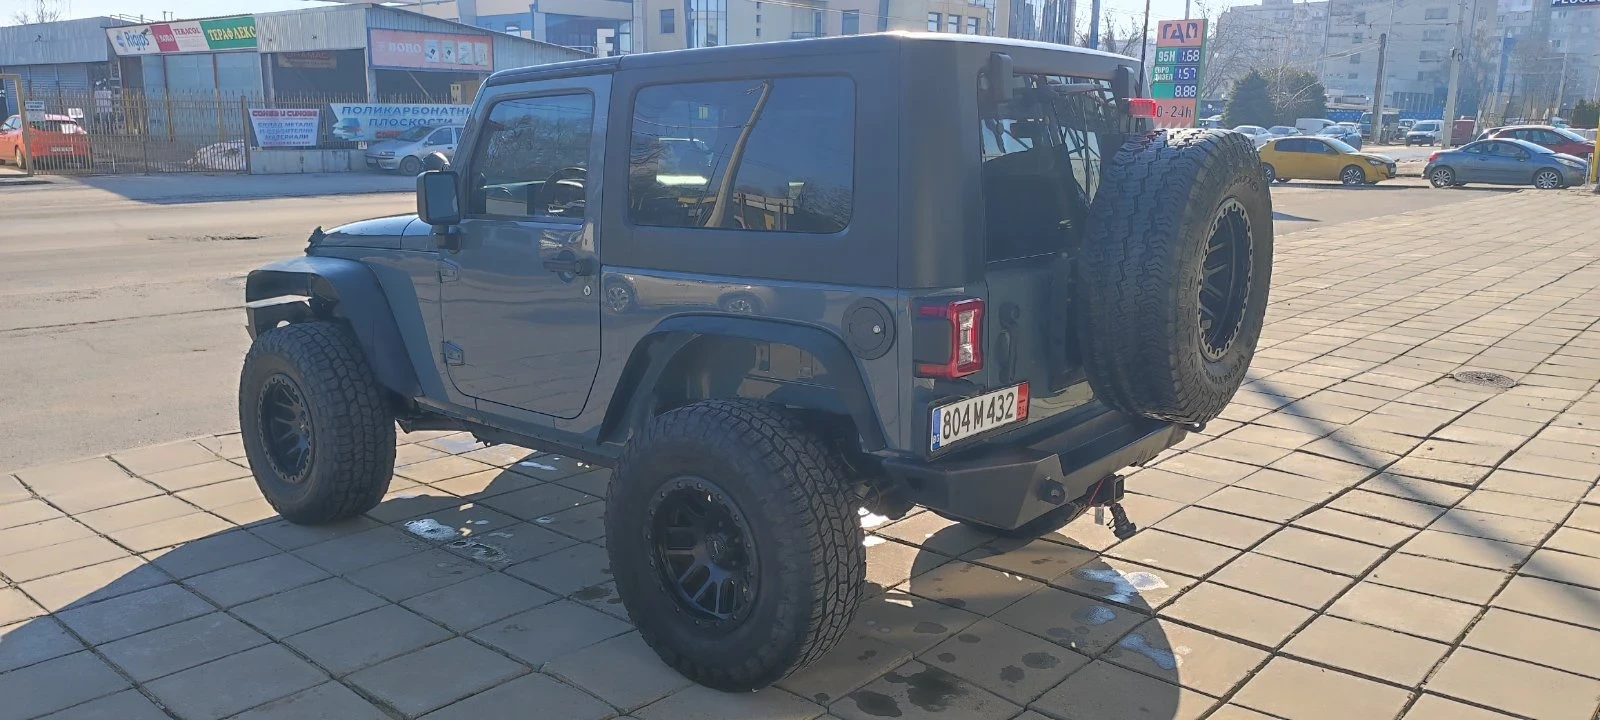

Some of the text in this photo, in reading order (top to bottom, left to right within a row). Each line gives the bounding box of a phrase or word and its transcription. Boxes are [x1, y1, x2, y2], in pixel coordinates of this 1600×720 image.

[124, 29, 150, 50] Rigips
[207, 26, 257, 41] ТЕРАФЛЕКС
[1182, 49, 1200, 62] 1.68
[1178, 67, 1197, 80] 1.57
[1174, 85, 1197, 97] 8.88
[943, 404, 970, 440] 804
[973, 400, 984, 430] M
[987, 392, 1015, 424] 432
